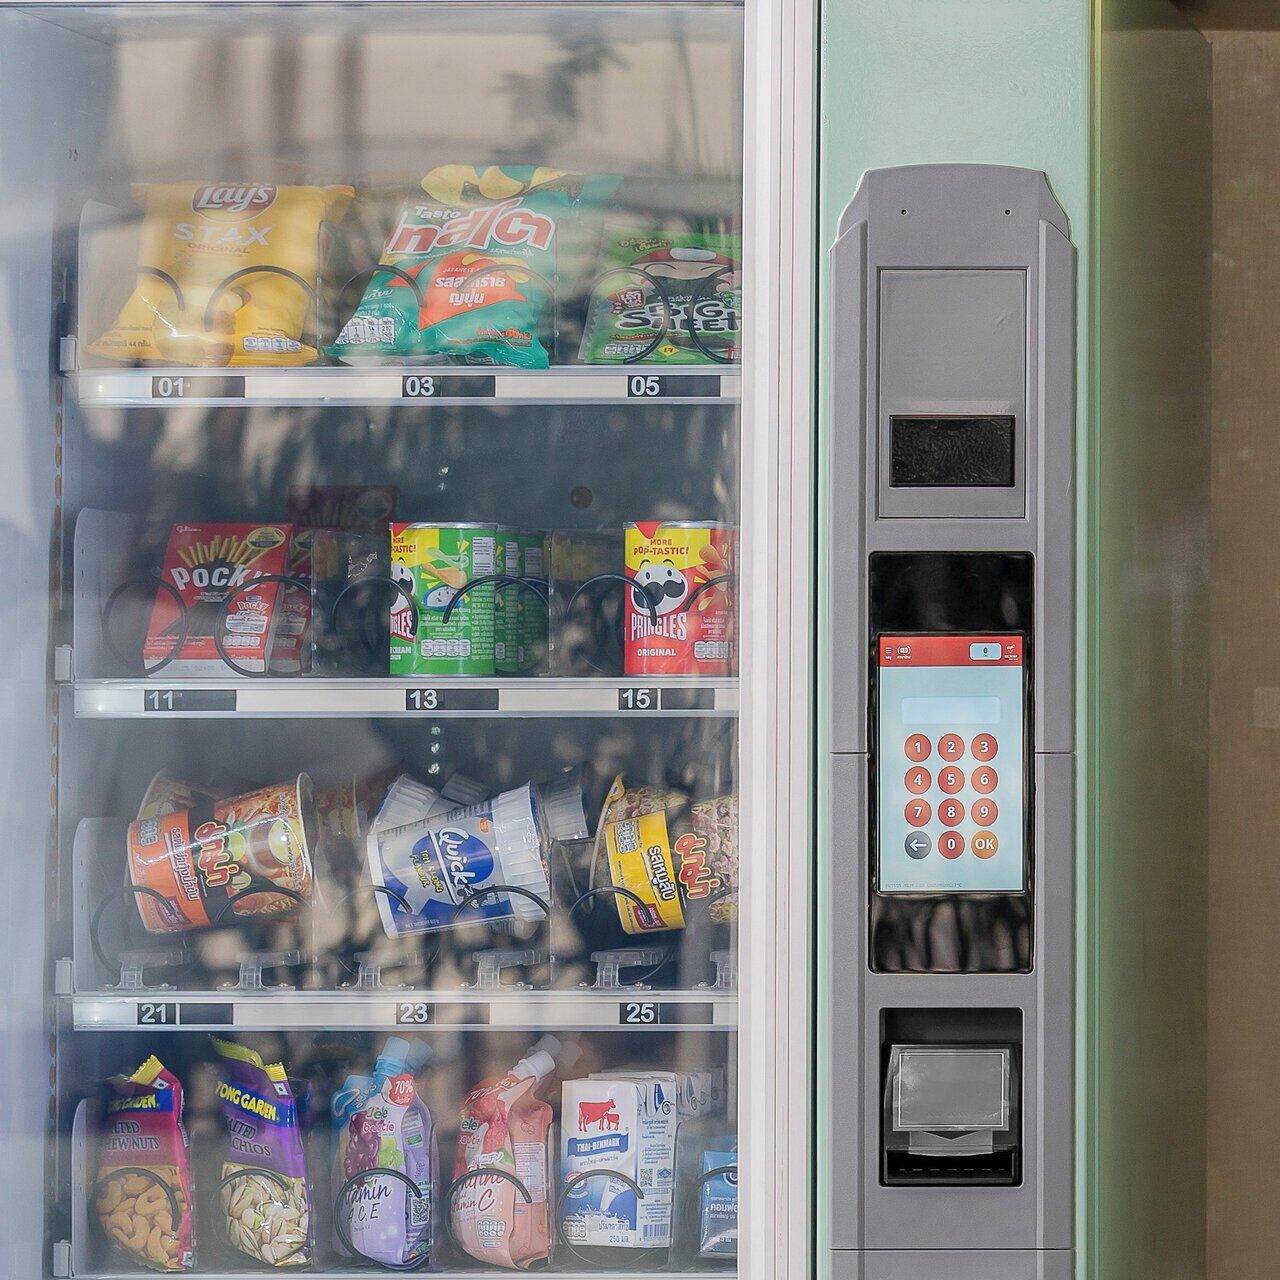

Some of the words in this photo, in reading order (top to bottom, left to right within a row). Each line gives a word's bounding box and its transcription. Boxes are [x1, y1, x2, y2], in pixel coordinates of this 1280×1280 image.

[415, 206, 461, 219] Tasto
[174, 223, 272, 246] STAX
[435, 273, 506, 288] รสสหร่าย
[158, 377, 186, 397] 01
[405, 377, 434, 397] 03
[631, 376, 660, 396] 05
[633, 546, 689, 556] POP-TASTIC!
[631, 612, 687, 642] PRINGLES
[637, 648, 677, 657] ORIGINAL
[149, 690, 174, 710] 11
[409, 689, 438, 709] 13
[622, 689, 650, 709] 15
[914, 742, 921, 752] 1
[947, 742, 955, 752] 2
[981, 742, 988, 752] 3
[914, 774, 922, 785] 4
[947, 774, 955, 785] 5
[980, 774, 989, 785] 6
[914, 806, 922, 817] 7
[947, 806, 955, 817] 8
[980, 806, 989, 817] 9
[947, 838, 956, 850] 0
[975, 838, 995, 850] OK
[439, 828, 475, 889] Quick
[674, 833, 720, 899] มาม่า
[648, 845, 677, 901] รสหมูสับ
[141, 1003, 166, 1022] 21
[400, 1003, 428, 1022] 23
[626, 1003, 655, 1023] 25
[215, 1081, 240, 1105] TONG
[394, 1080, 413, 1095] 70%
[577, 1138, 620, 1152] THAI-DENMARK
[478, 1188, 495, 1212] C
